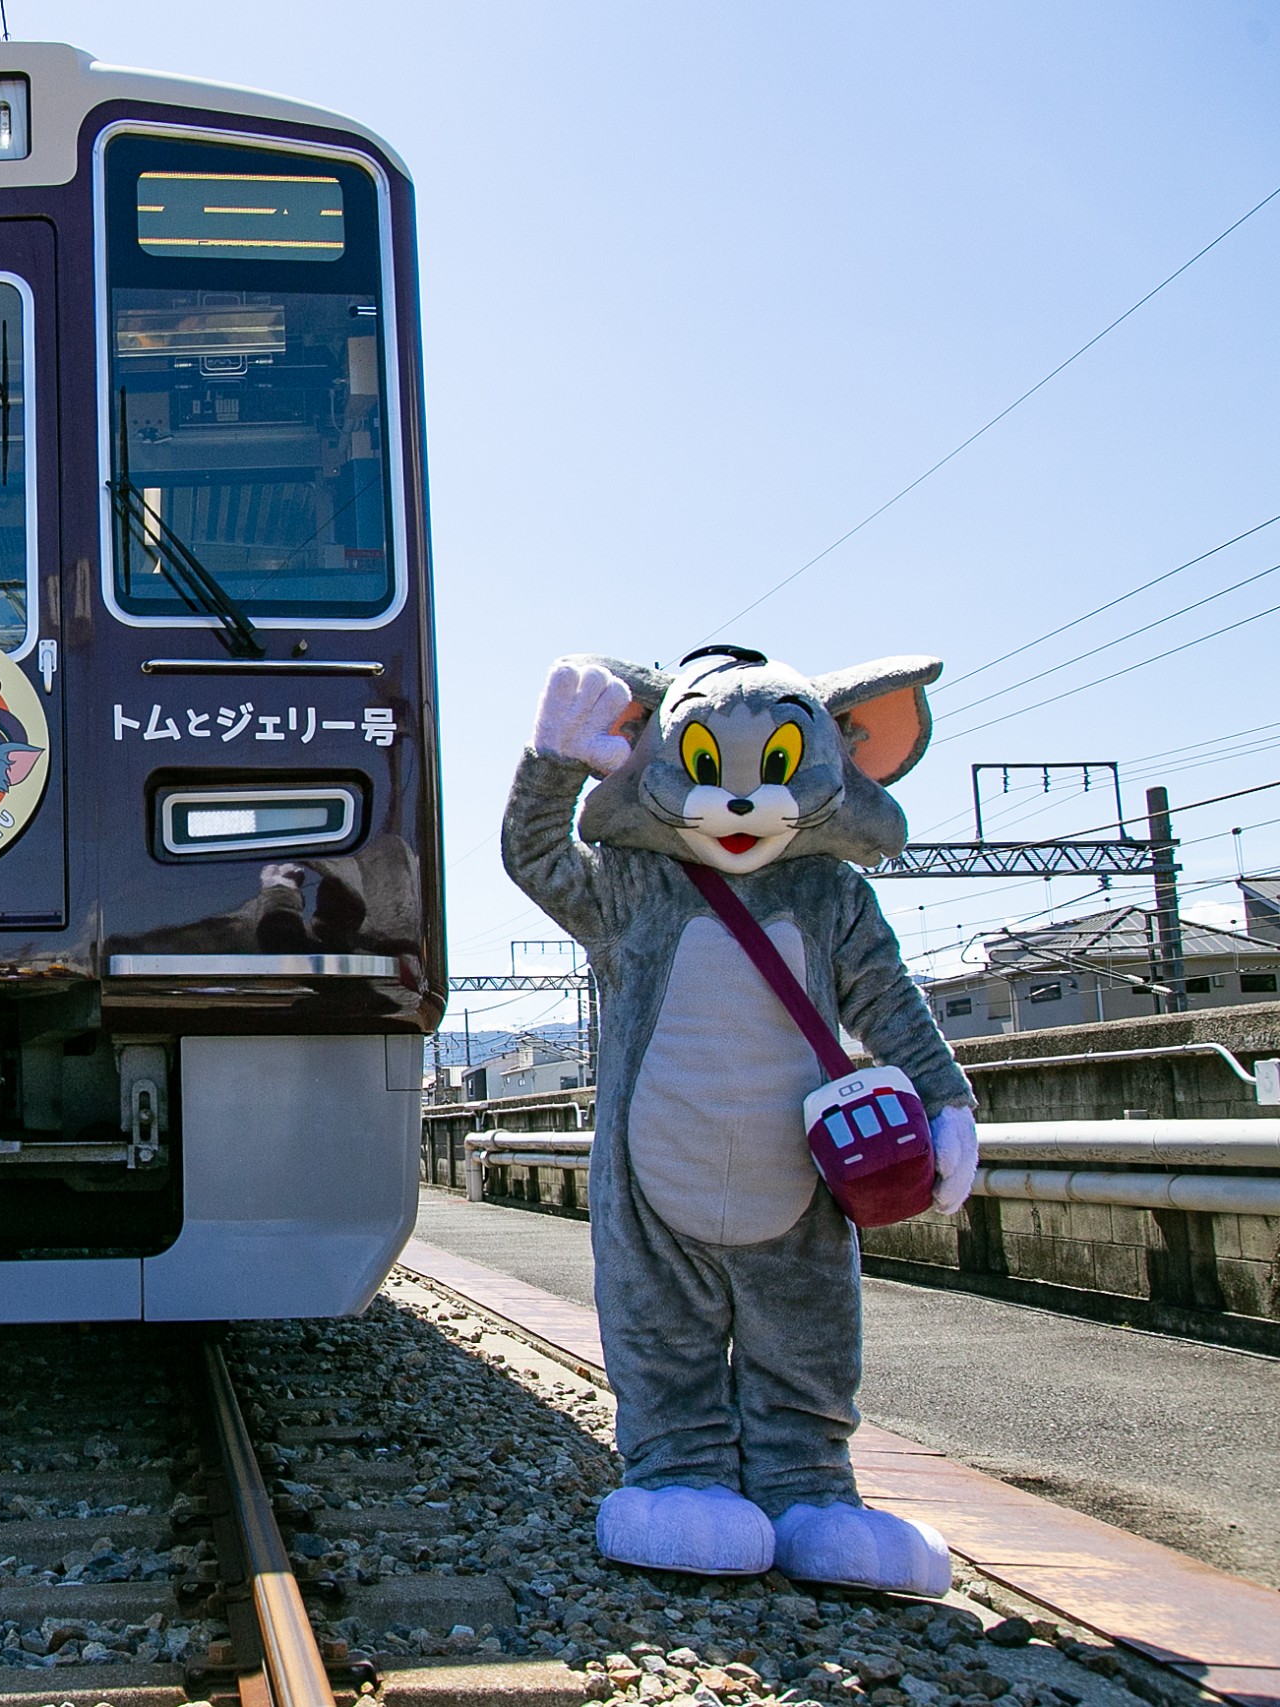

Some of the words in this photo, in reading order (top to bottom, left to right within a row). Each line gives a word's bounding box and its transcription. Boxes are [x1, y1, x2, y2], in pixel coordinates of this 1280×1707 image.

[113, 702, 398, 747] トムとジェリー号
